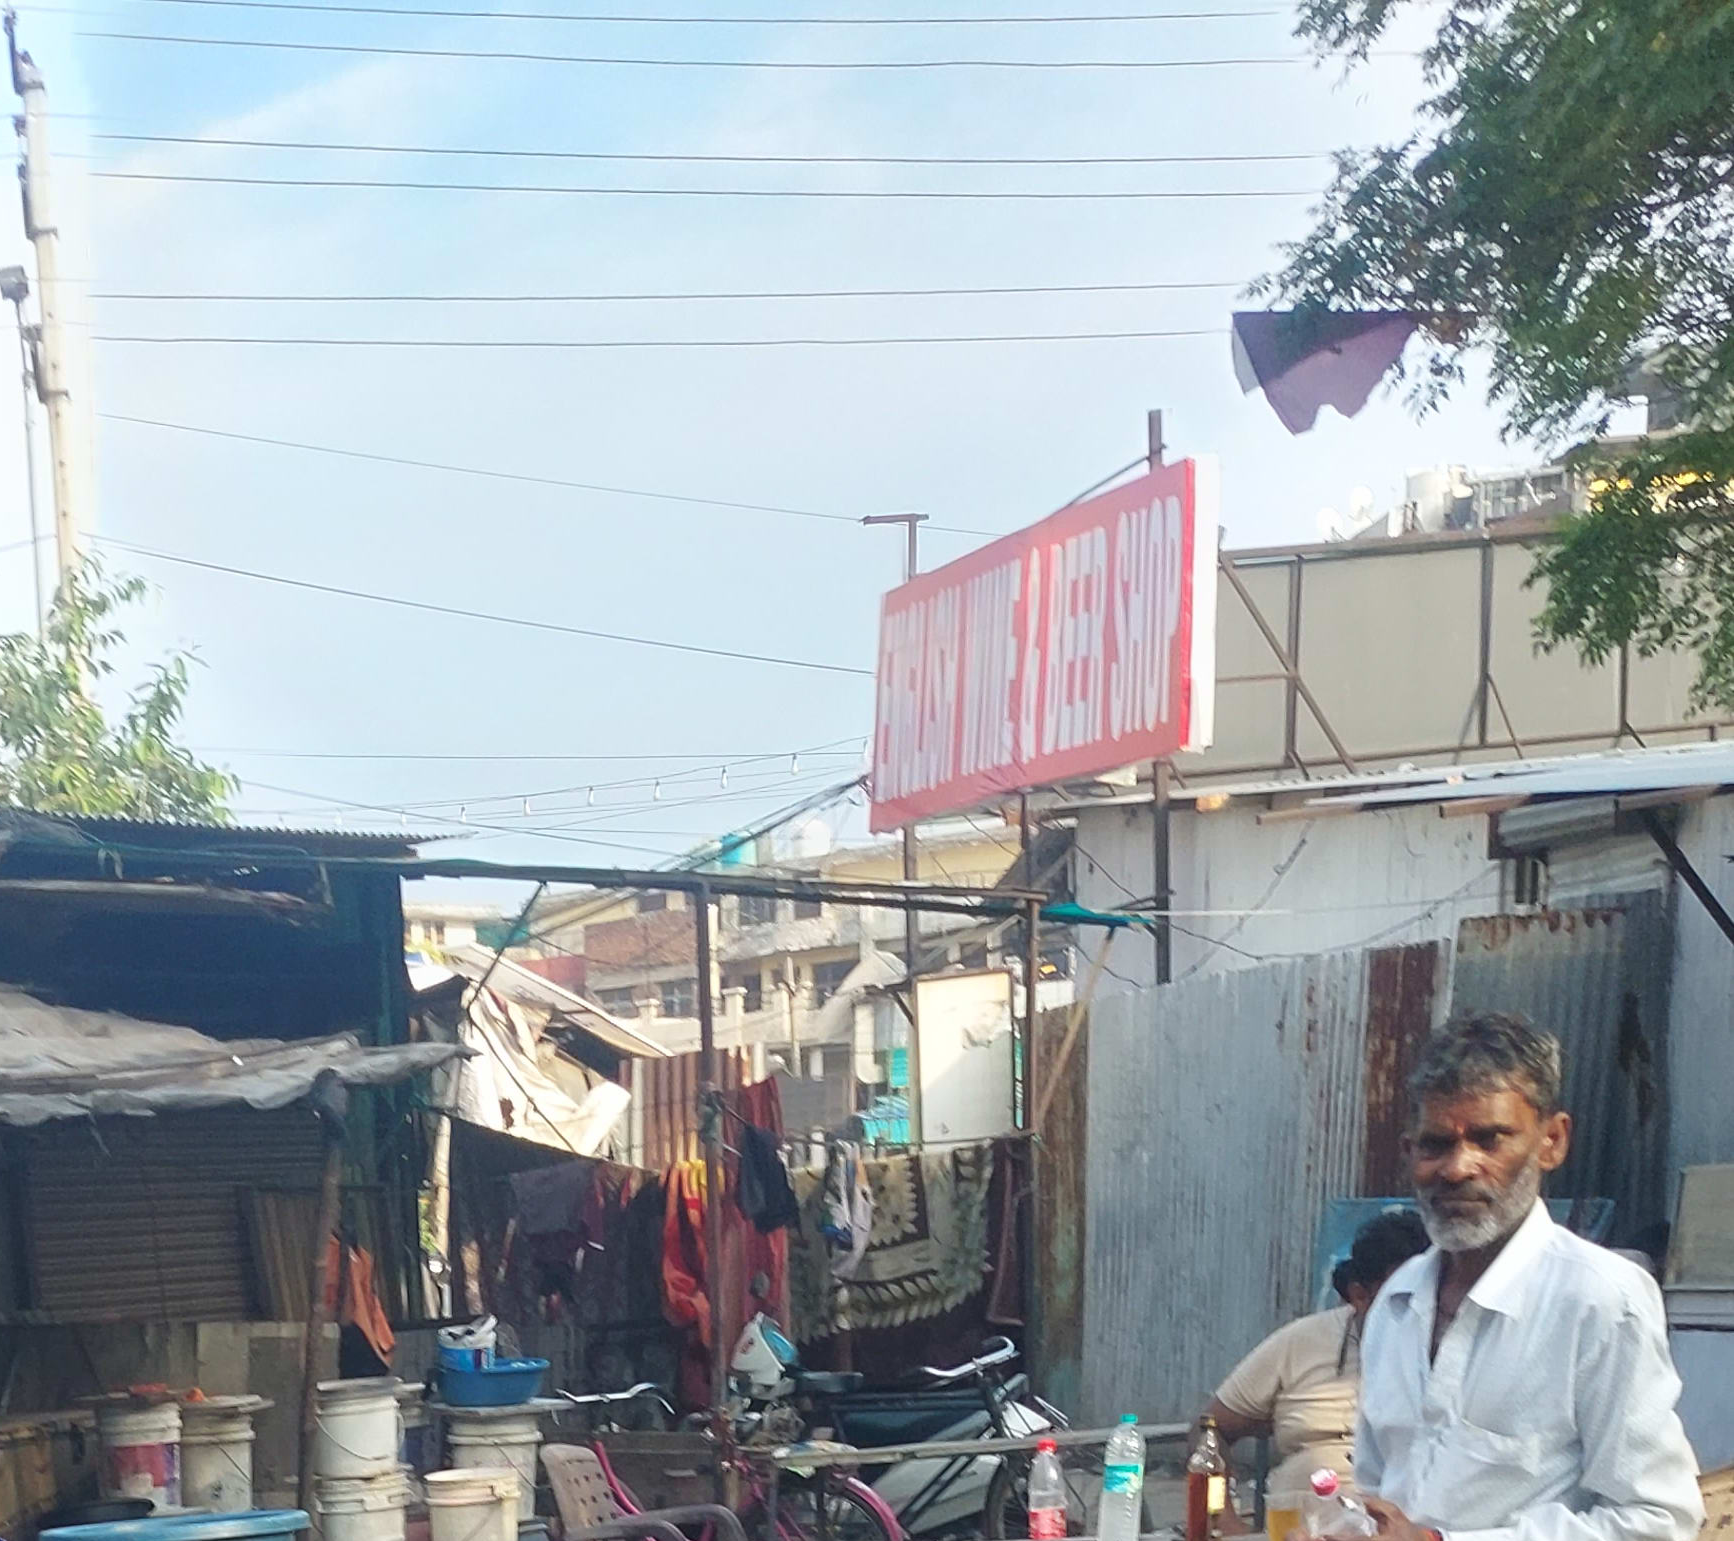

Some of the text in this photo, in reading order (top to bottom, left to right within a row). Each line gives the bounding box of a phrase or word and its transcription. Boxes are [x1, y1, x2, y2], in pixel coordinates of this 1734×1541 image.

[1019, 546, 1041, 764] &
[1042, 525, 1108, 755] BEER
[1110, 494, 1183, 742] SHOP
